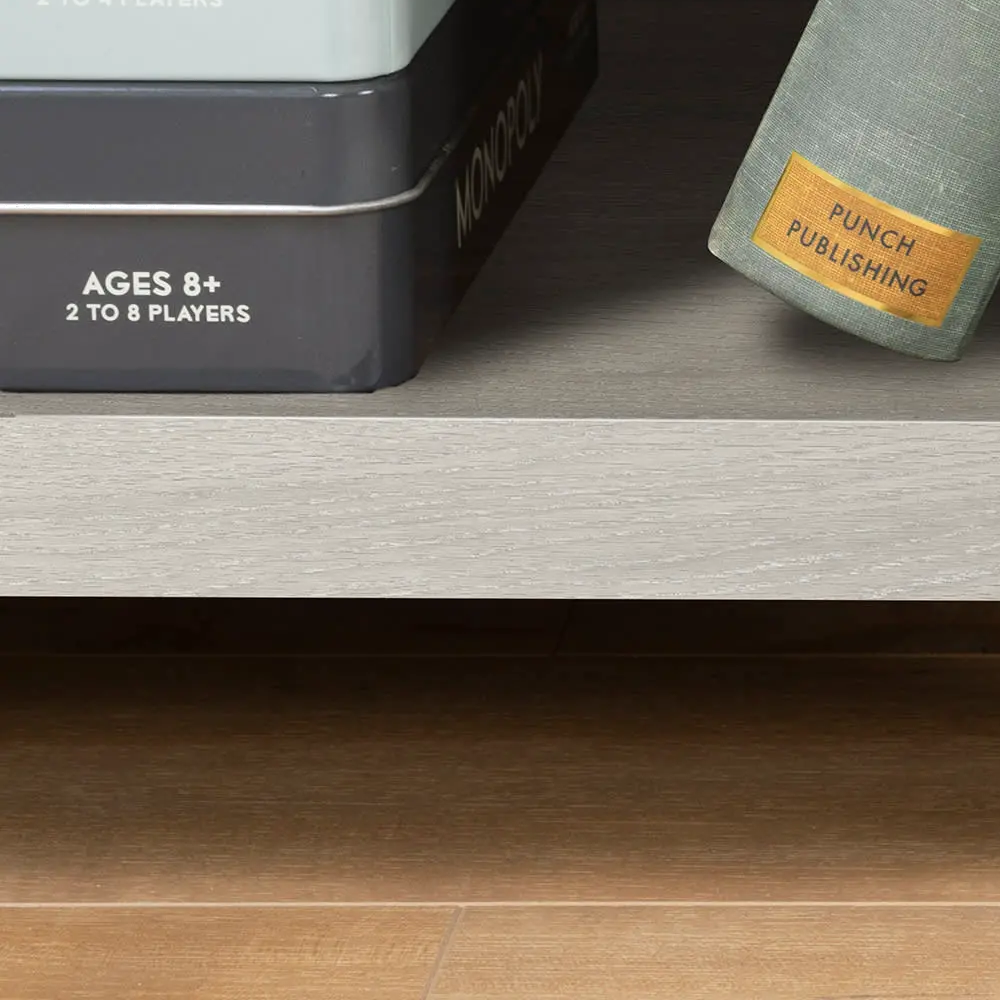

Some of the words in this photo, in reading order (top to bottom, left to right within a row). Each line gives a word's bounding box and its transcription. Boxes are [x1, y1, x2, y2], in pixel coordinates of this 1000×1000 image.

[455, 49, 544, 249] MONOPOLY
[828, 202, 917, 257] PUNCH
[82, 270, 172, 296] AGES
[183, 271, 221, 297] 8+
[786, 219, 928, 297] PUBLISHING
[65, 303, 79, 321] 2
[86, 303, 119, 322] TO
[127, 303, 141, 322] 8
[148, 304, 251, 323] PLAYERS
